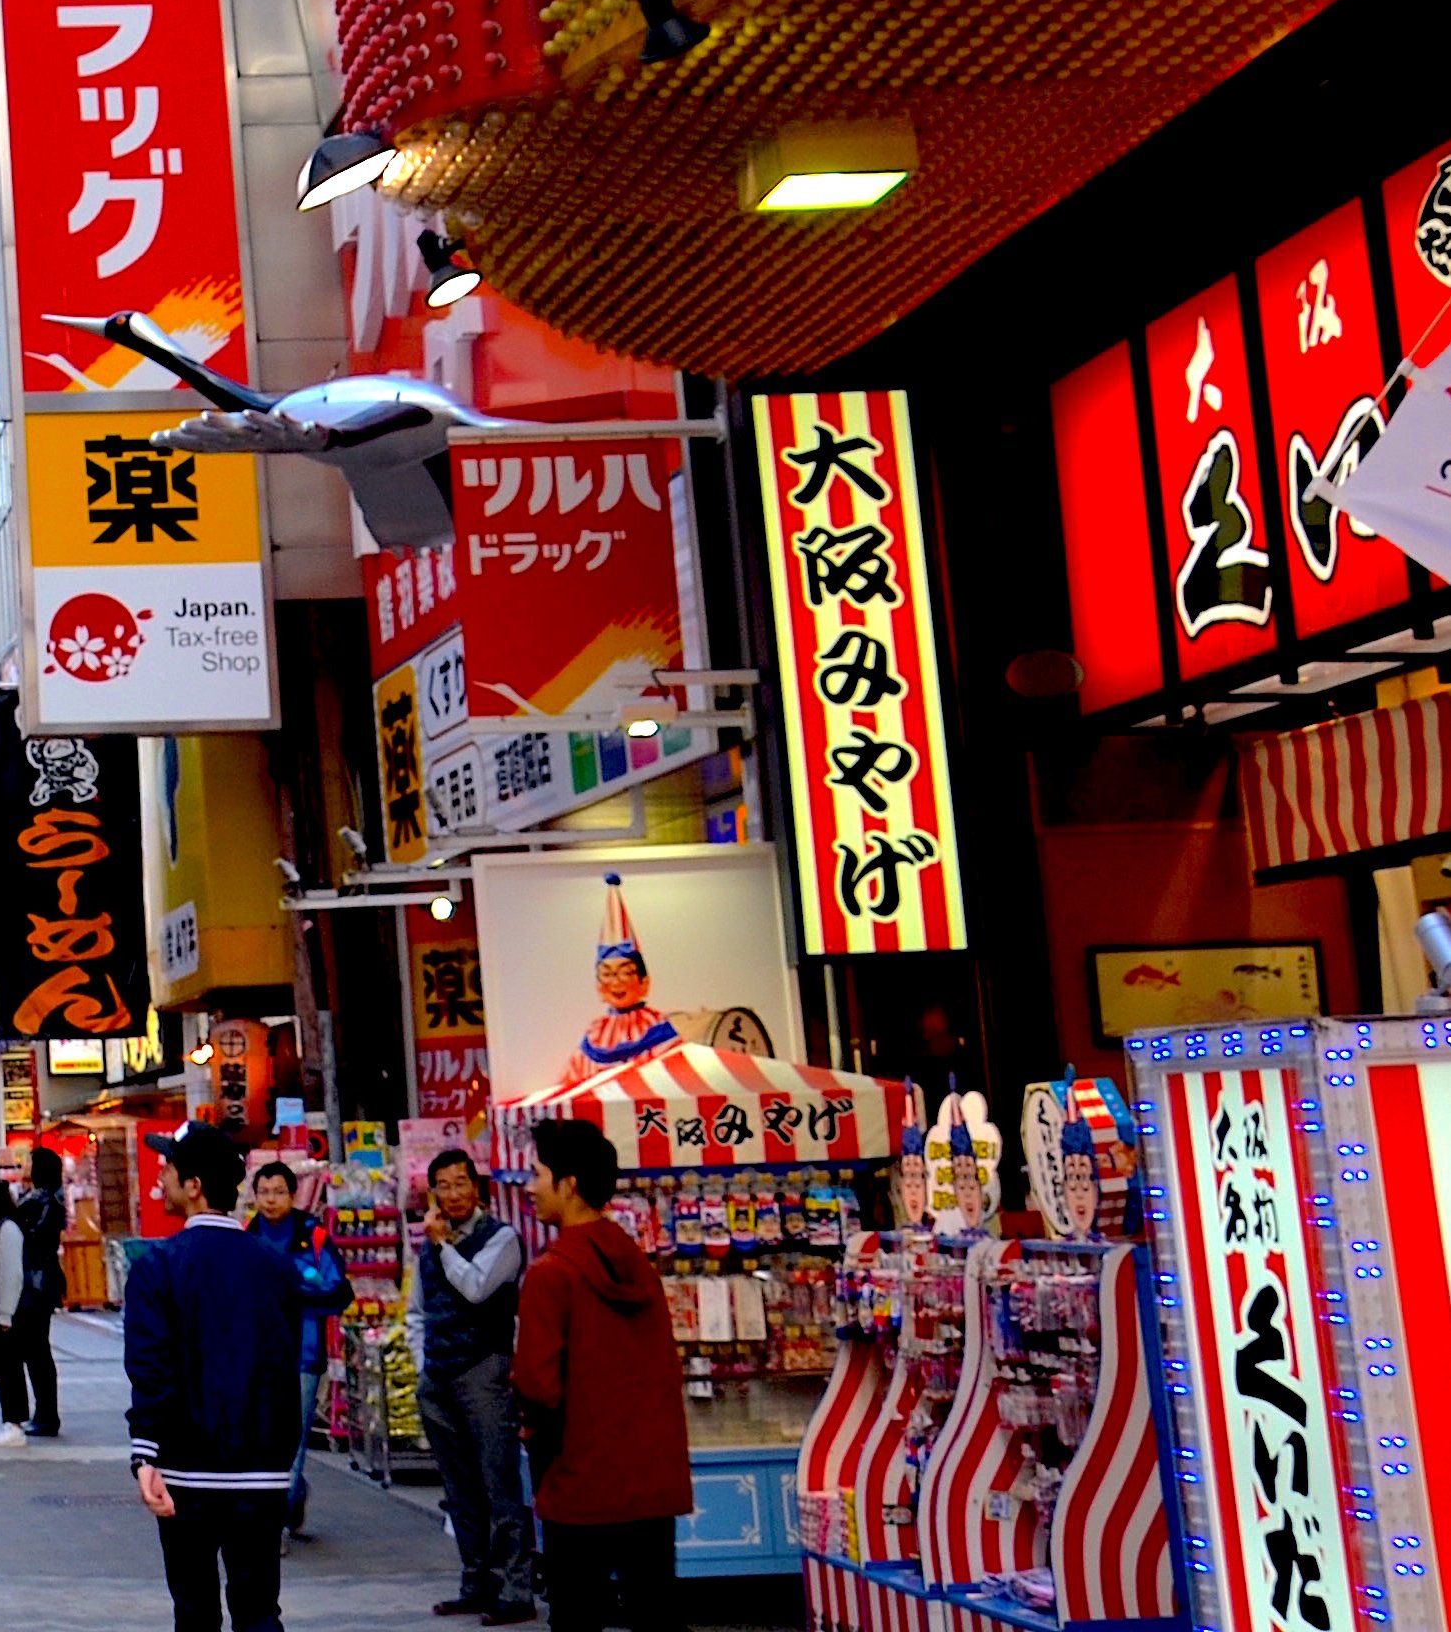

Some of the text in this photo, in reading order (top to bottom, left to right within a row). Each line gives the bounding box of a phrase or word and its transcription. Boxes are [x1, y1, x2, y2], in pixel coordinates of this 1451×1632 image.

[85, 435, 198, 543] 薬
[461, 454, 661, 515] ツルハ
[469, 529, 627, 576] ドラッグ
[165, 626, 258, 647] Tax-free
[175, 598, 256, 620] Japan.
[202, 652, 260, 676] Shop
[784, 427, 938, 918] 大阪みやげ
[381, 691, 422, 848] 薬
[14, 808, 132, 1035] らーめん
[637, 1100, 855, 1147] 大阪みやげ
[1211, 1105, 1269, 1164] 大阪
[1223, 1187, 1281, 1245] 名物
